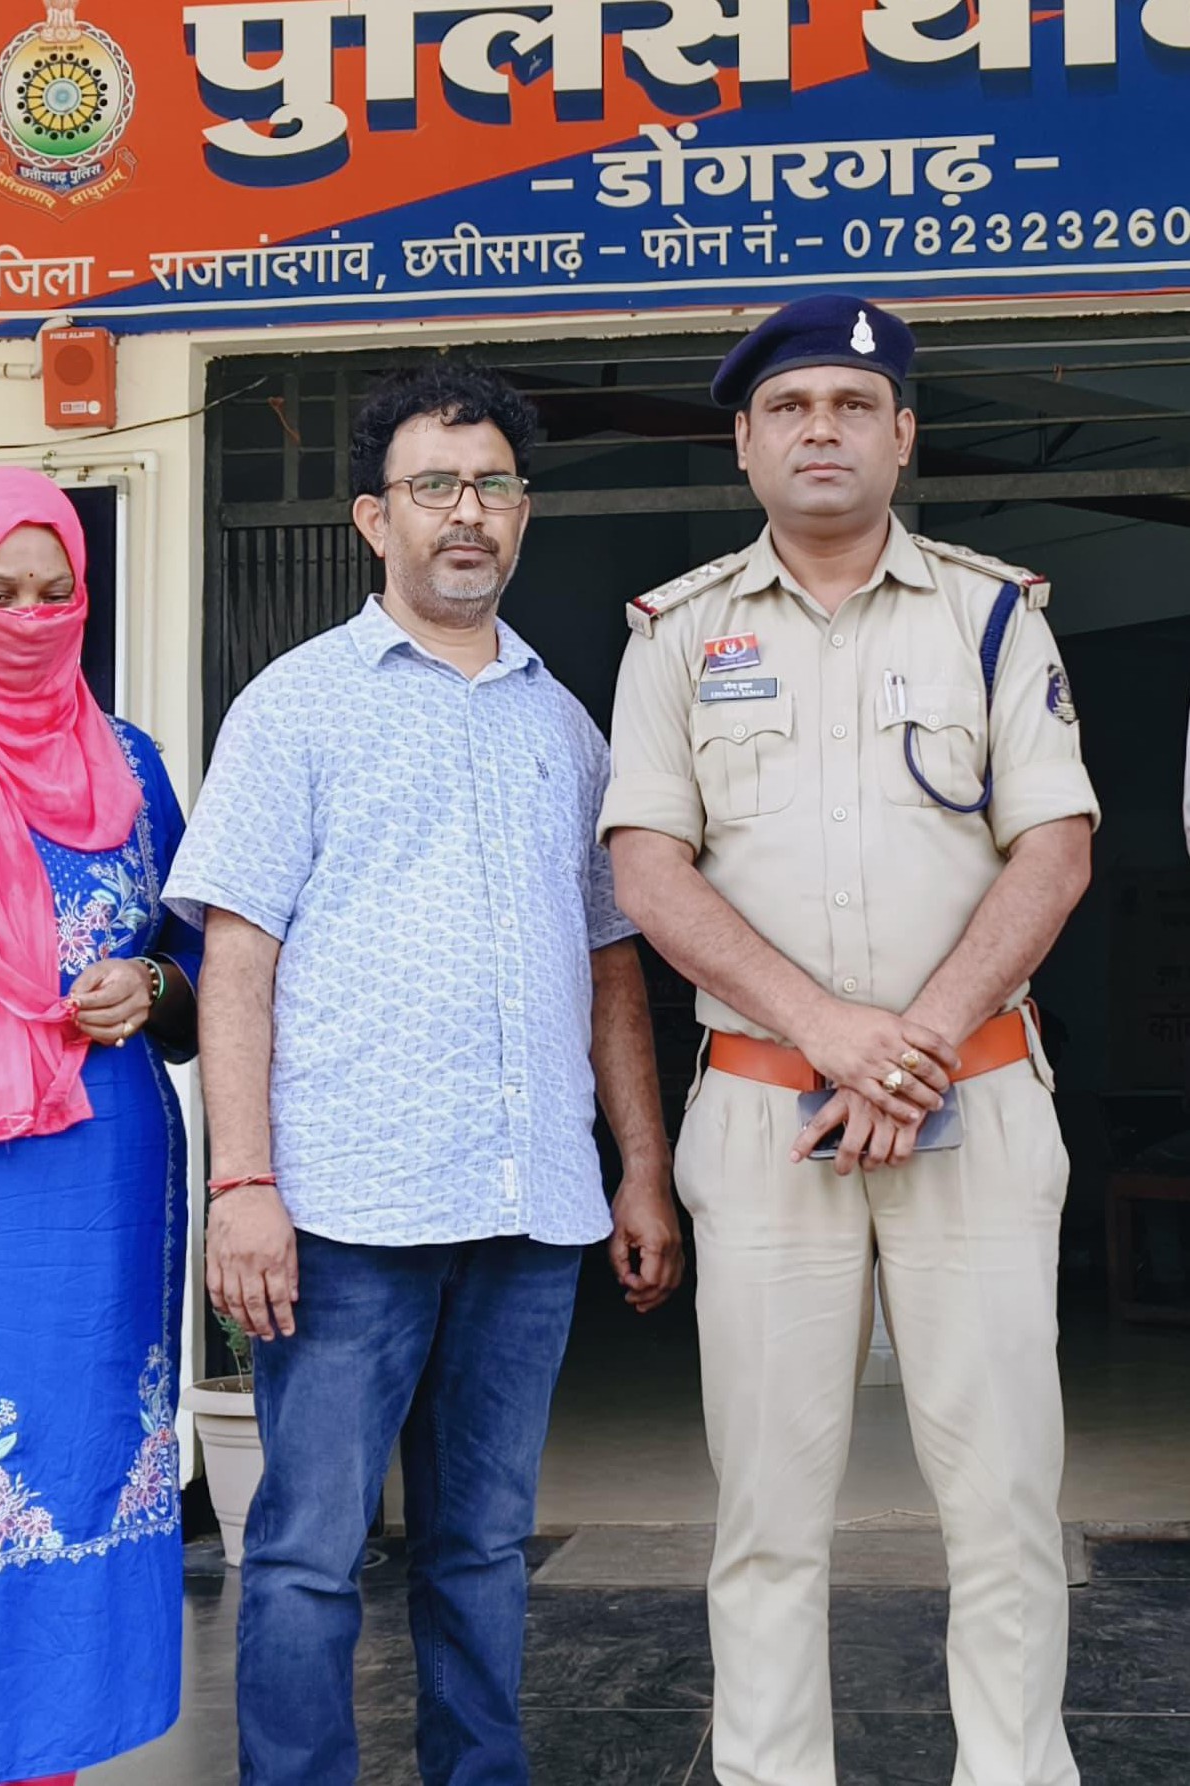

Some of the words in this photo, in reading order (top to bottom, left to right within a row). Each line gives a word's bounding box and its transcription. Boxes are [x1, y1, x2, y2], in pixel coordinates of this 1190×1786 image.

[593, 123, 996, 208] डोंगरगढ़
[401, 222, 585, 280] छत्तीसगढ़
[641, 212, 733, 269] फोन
